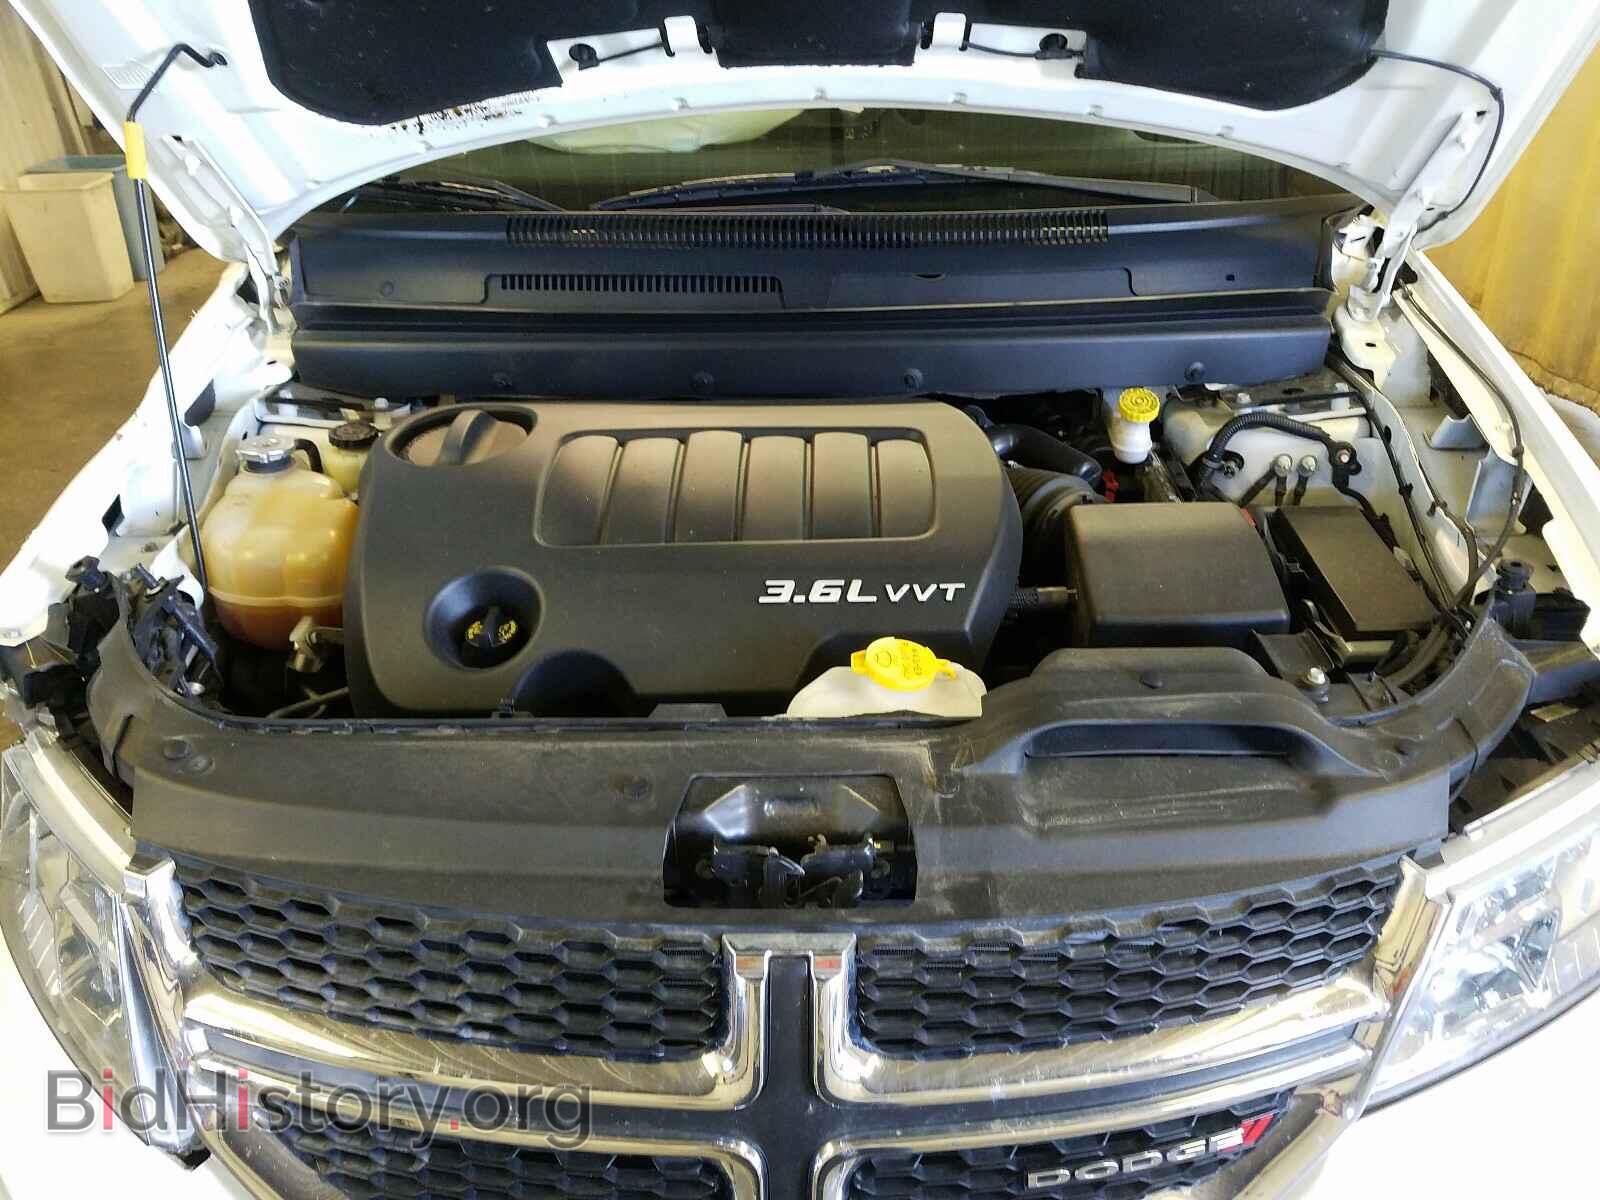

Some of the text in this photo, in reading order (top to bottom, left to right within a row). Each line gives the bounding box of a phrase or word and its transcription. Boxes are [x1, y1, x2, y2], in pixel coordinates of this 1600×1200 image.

[758, 579, 966, 603] 3.6L VVT
[1027, 1128, 1244, 1189] DODGE
